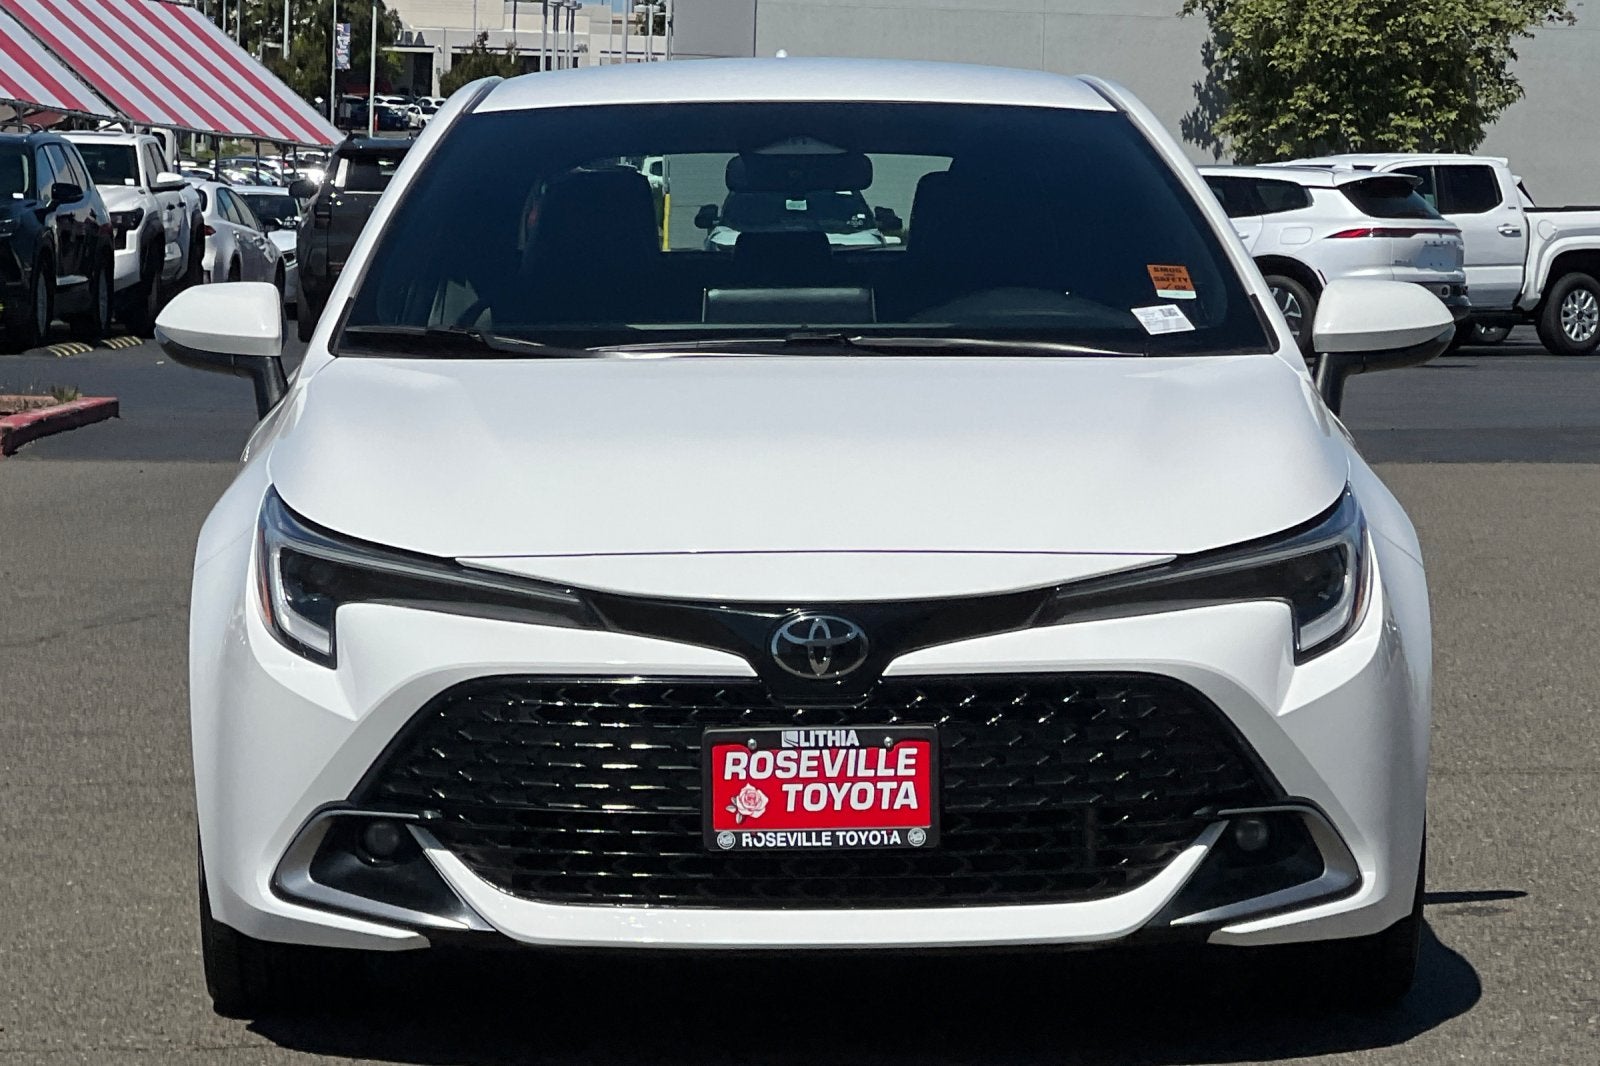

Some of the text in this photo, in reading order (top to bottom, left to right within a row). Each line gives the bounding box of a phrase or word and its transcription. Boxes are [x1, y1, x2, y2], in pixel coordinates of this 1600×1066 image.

[798, 730, 859, 747] LITHIA
[724, 748, 918, 780] ROSEVILLE
[782, 782, 918, 812] TOYOTA
[742, 830, 901, 847] ROSEVILLE TOYOTA
